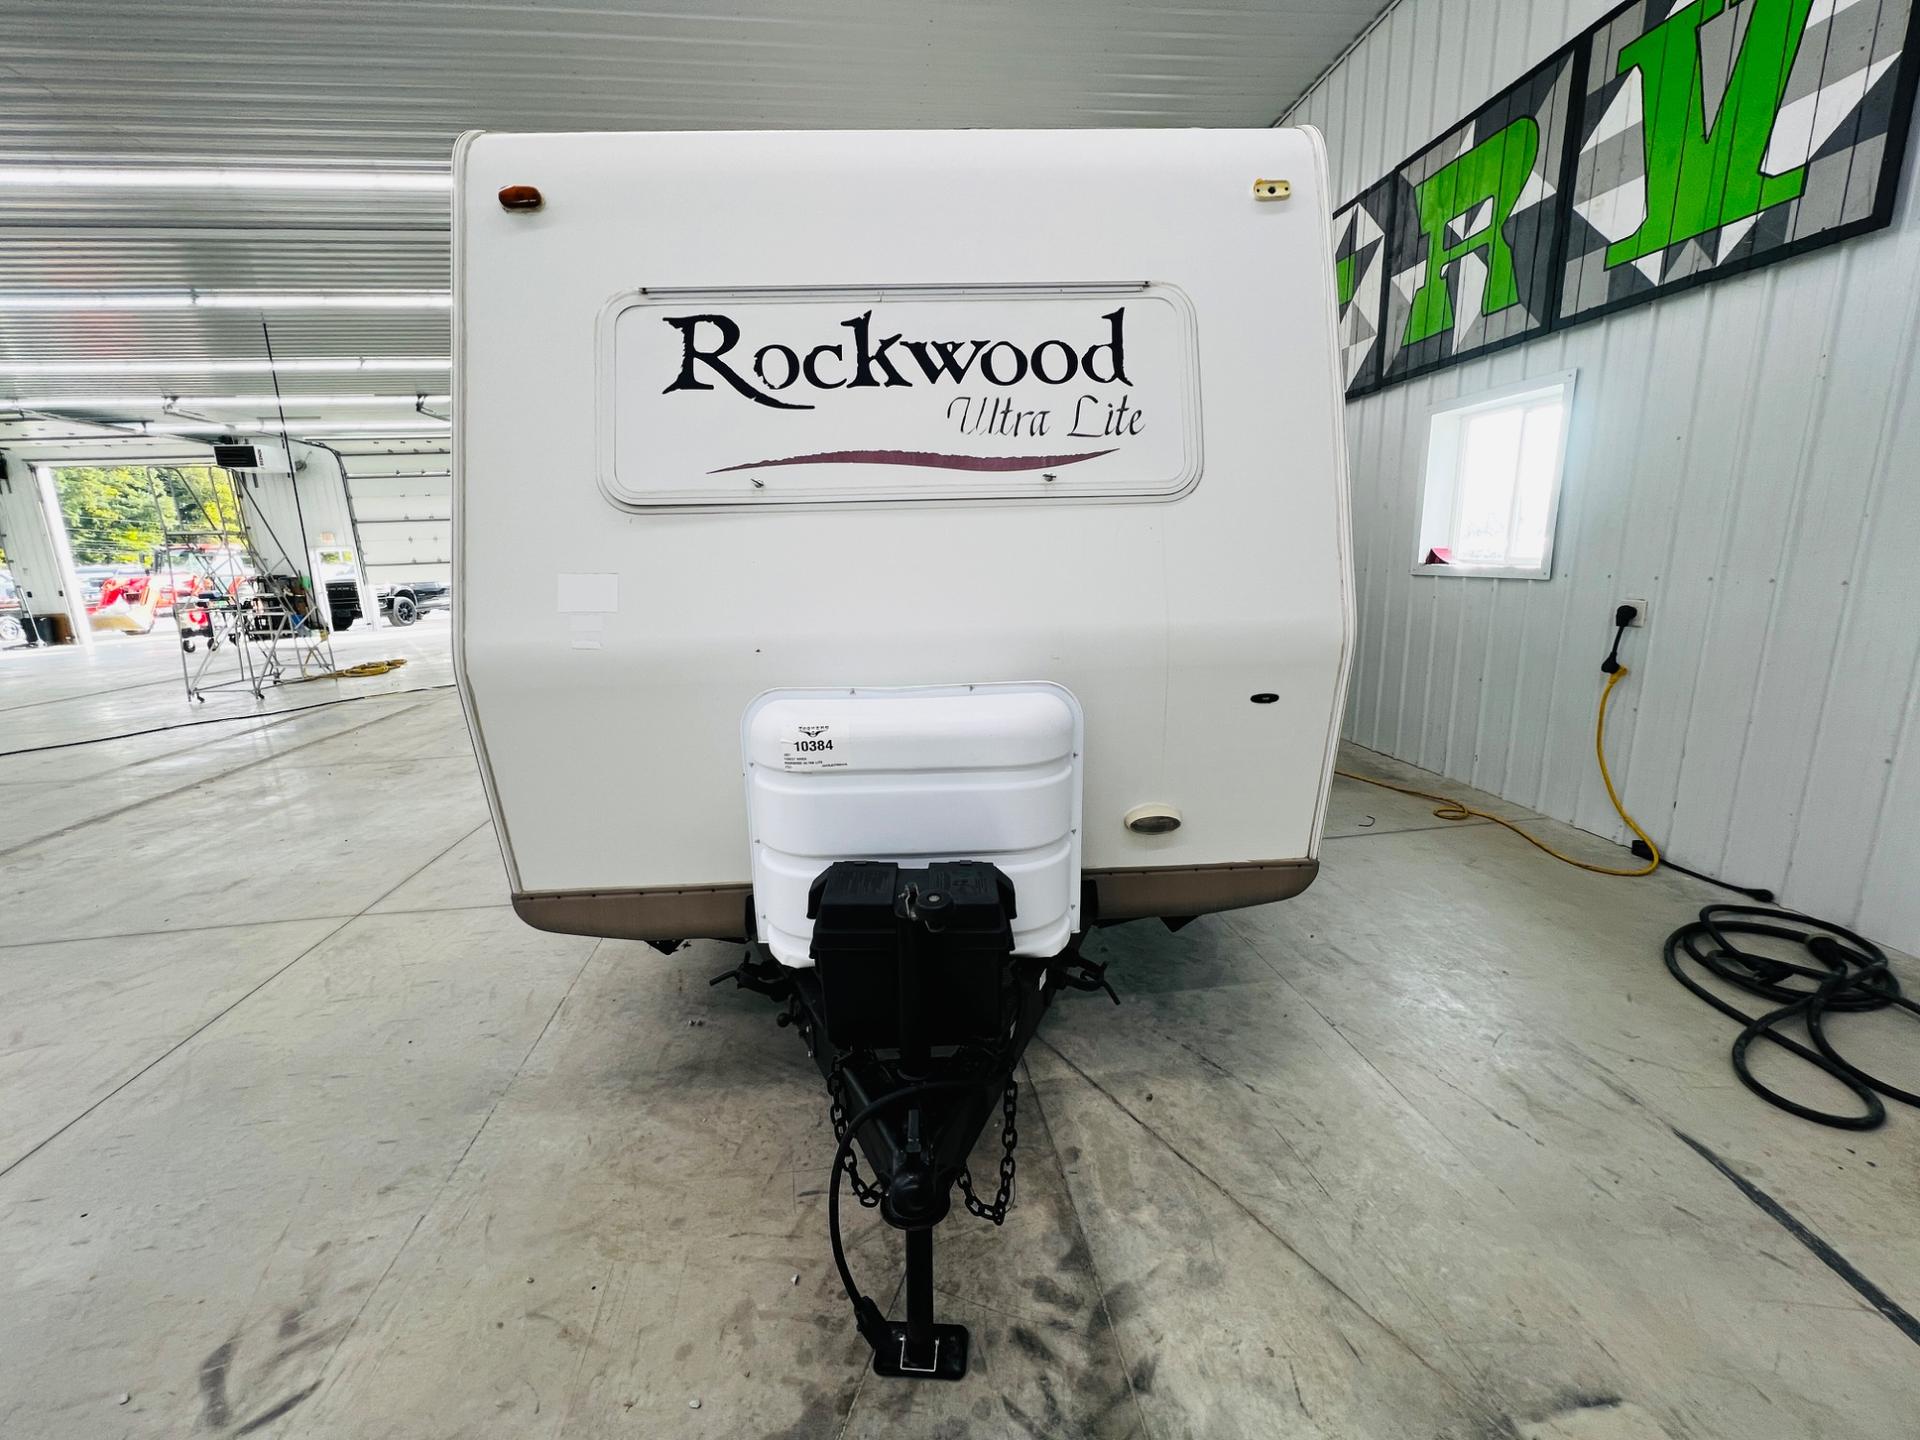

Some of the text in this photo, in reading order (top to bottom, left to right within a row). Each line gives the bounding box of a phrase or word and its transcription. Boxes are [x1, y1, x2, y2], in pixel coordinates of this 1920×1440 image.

[663, 307, 1133, 409] Rockwood
[947, 394, 1146, 438] Ultra Lite
[794, 740, 833, 751] 10384
